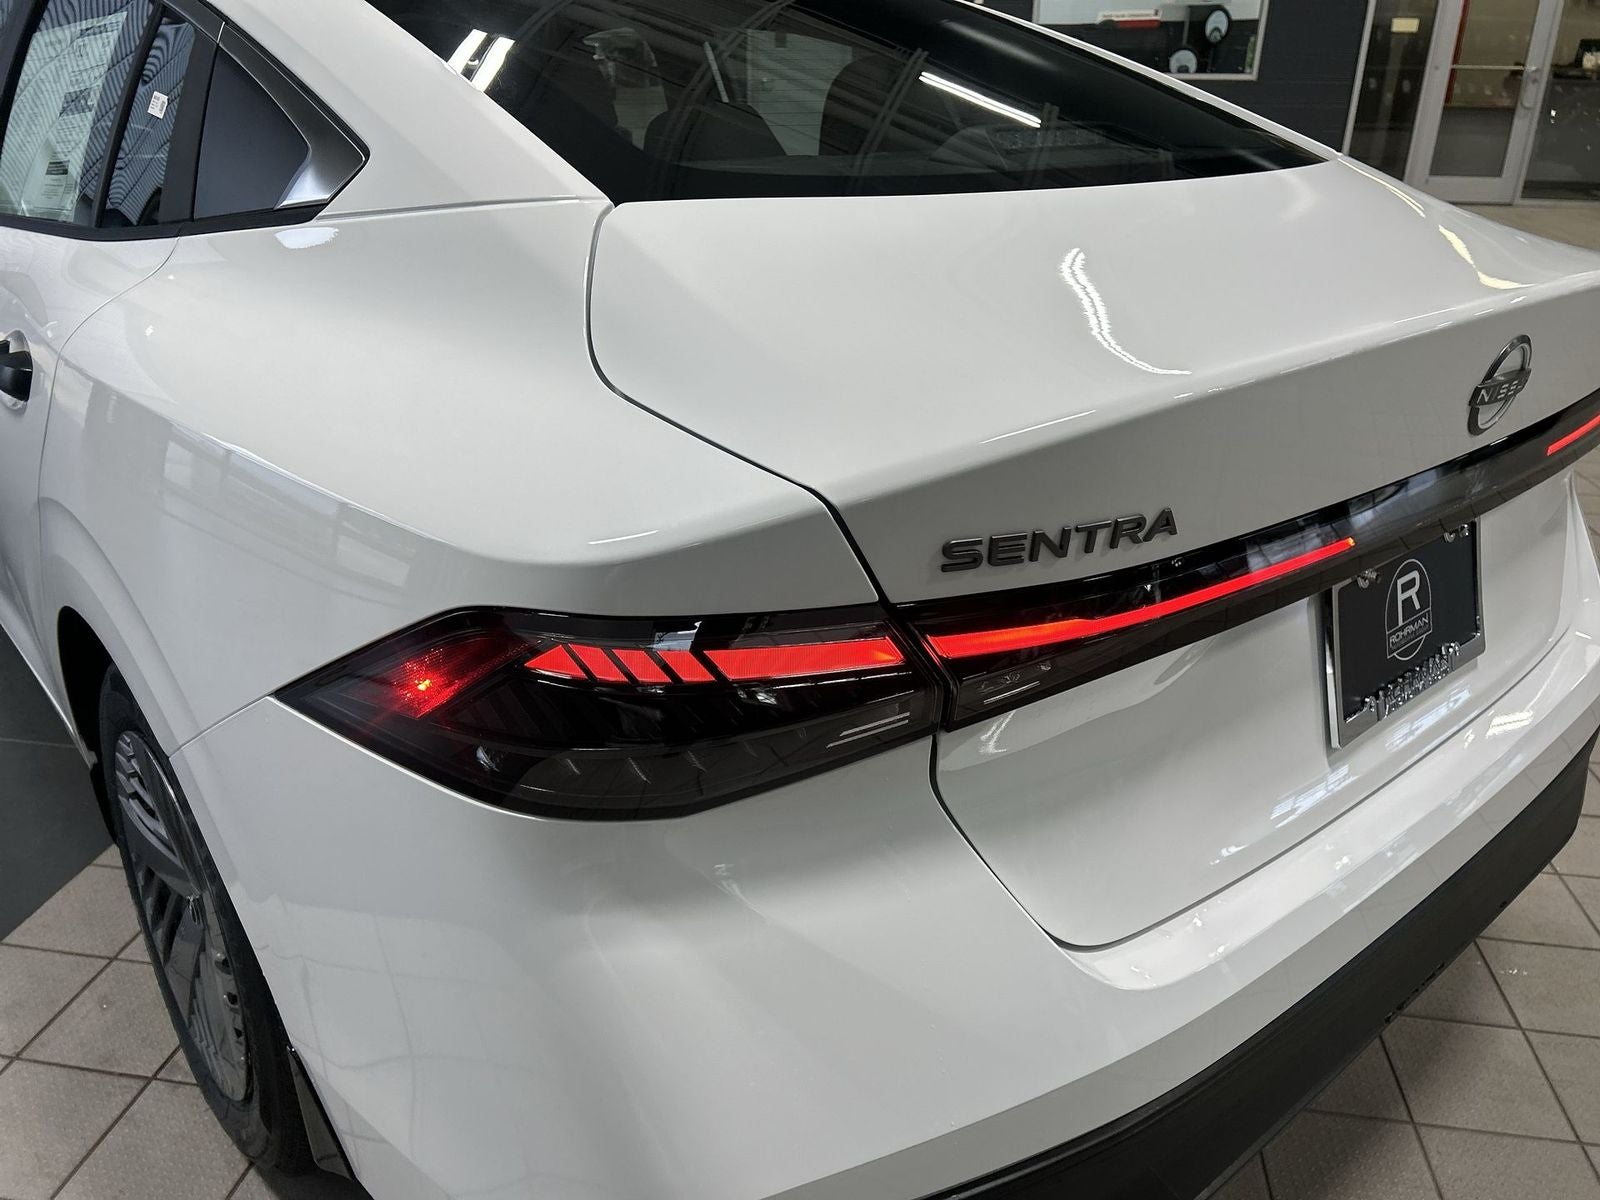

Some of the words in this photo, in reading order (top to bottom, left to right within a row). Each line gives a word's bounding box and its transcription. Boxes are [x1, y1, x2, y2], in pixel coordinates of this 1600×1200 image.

[941, 507, 1177, 573] SENTRA
[1397, 570, 1421, 627] R
[1389, 612, 1429, 648] ROHRMAN
